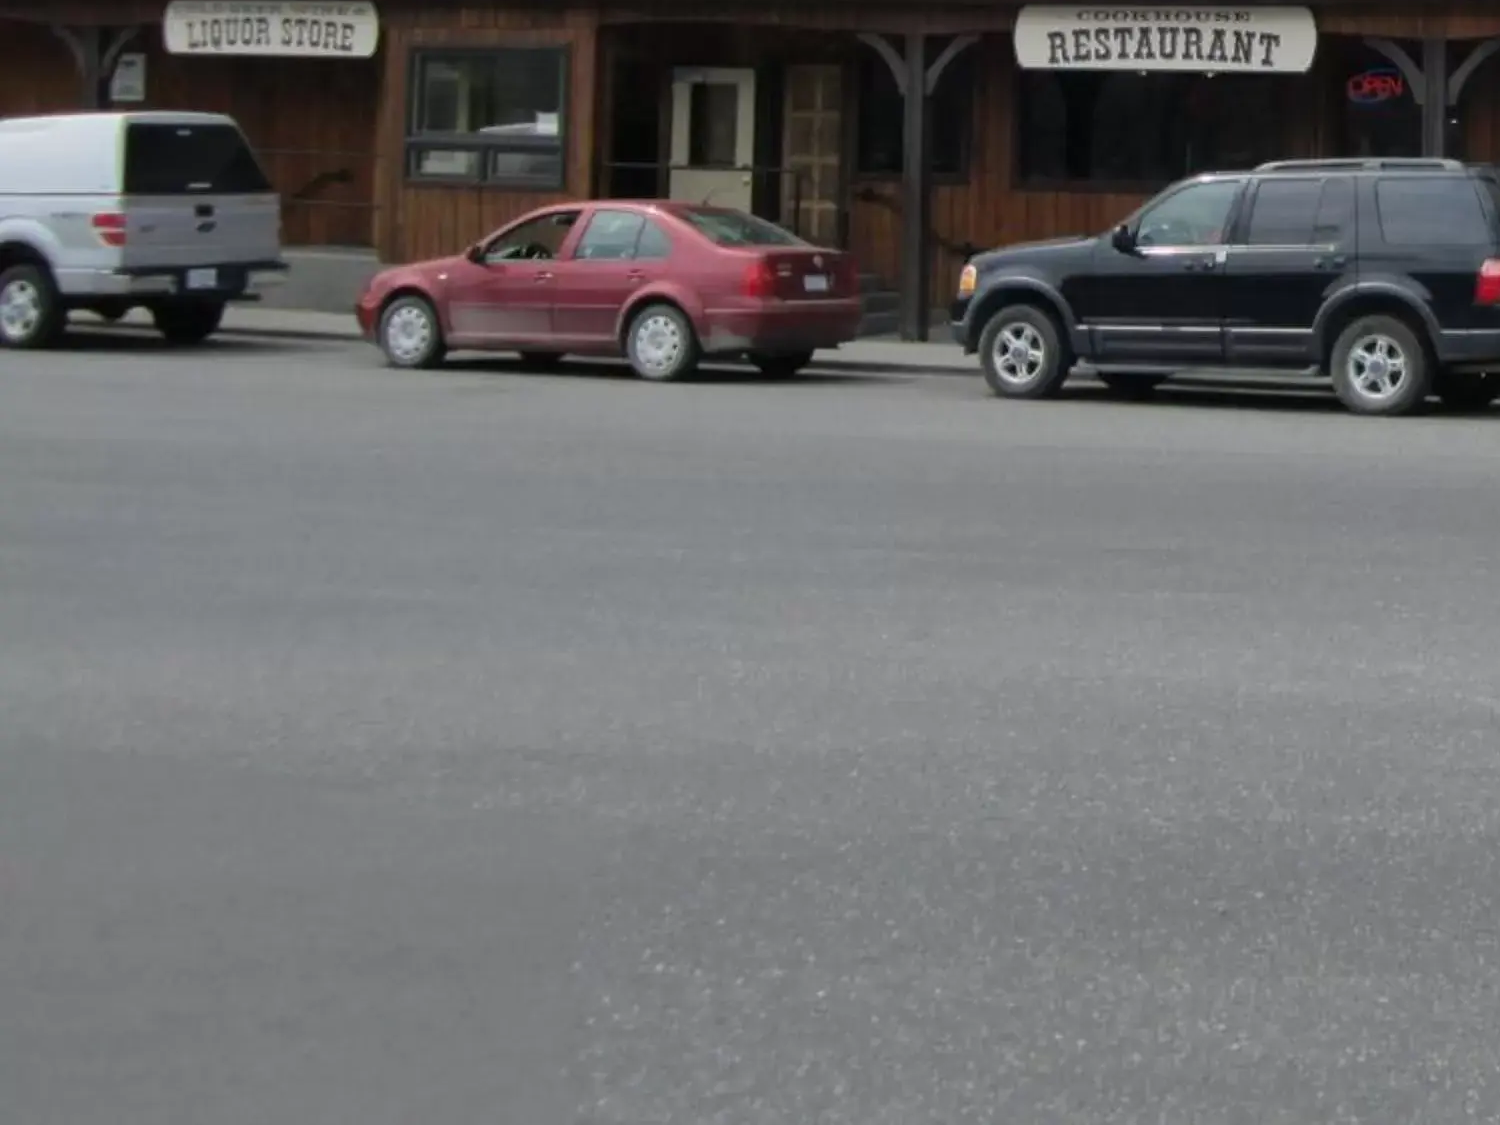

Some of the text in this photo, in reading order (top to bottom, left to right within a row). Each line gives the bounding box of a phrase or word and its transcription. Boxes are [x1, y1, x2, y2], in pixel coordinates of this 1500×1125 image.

[1076, 9, 1250, 22] COOKHOUSE
[186, 17, 355, 52] LIQUOR STORE
[1047, 26, 1281, 66] RESTAURANT
[1347, 75, 1403, 100] OPEN
